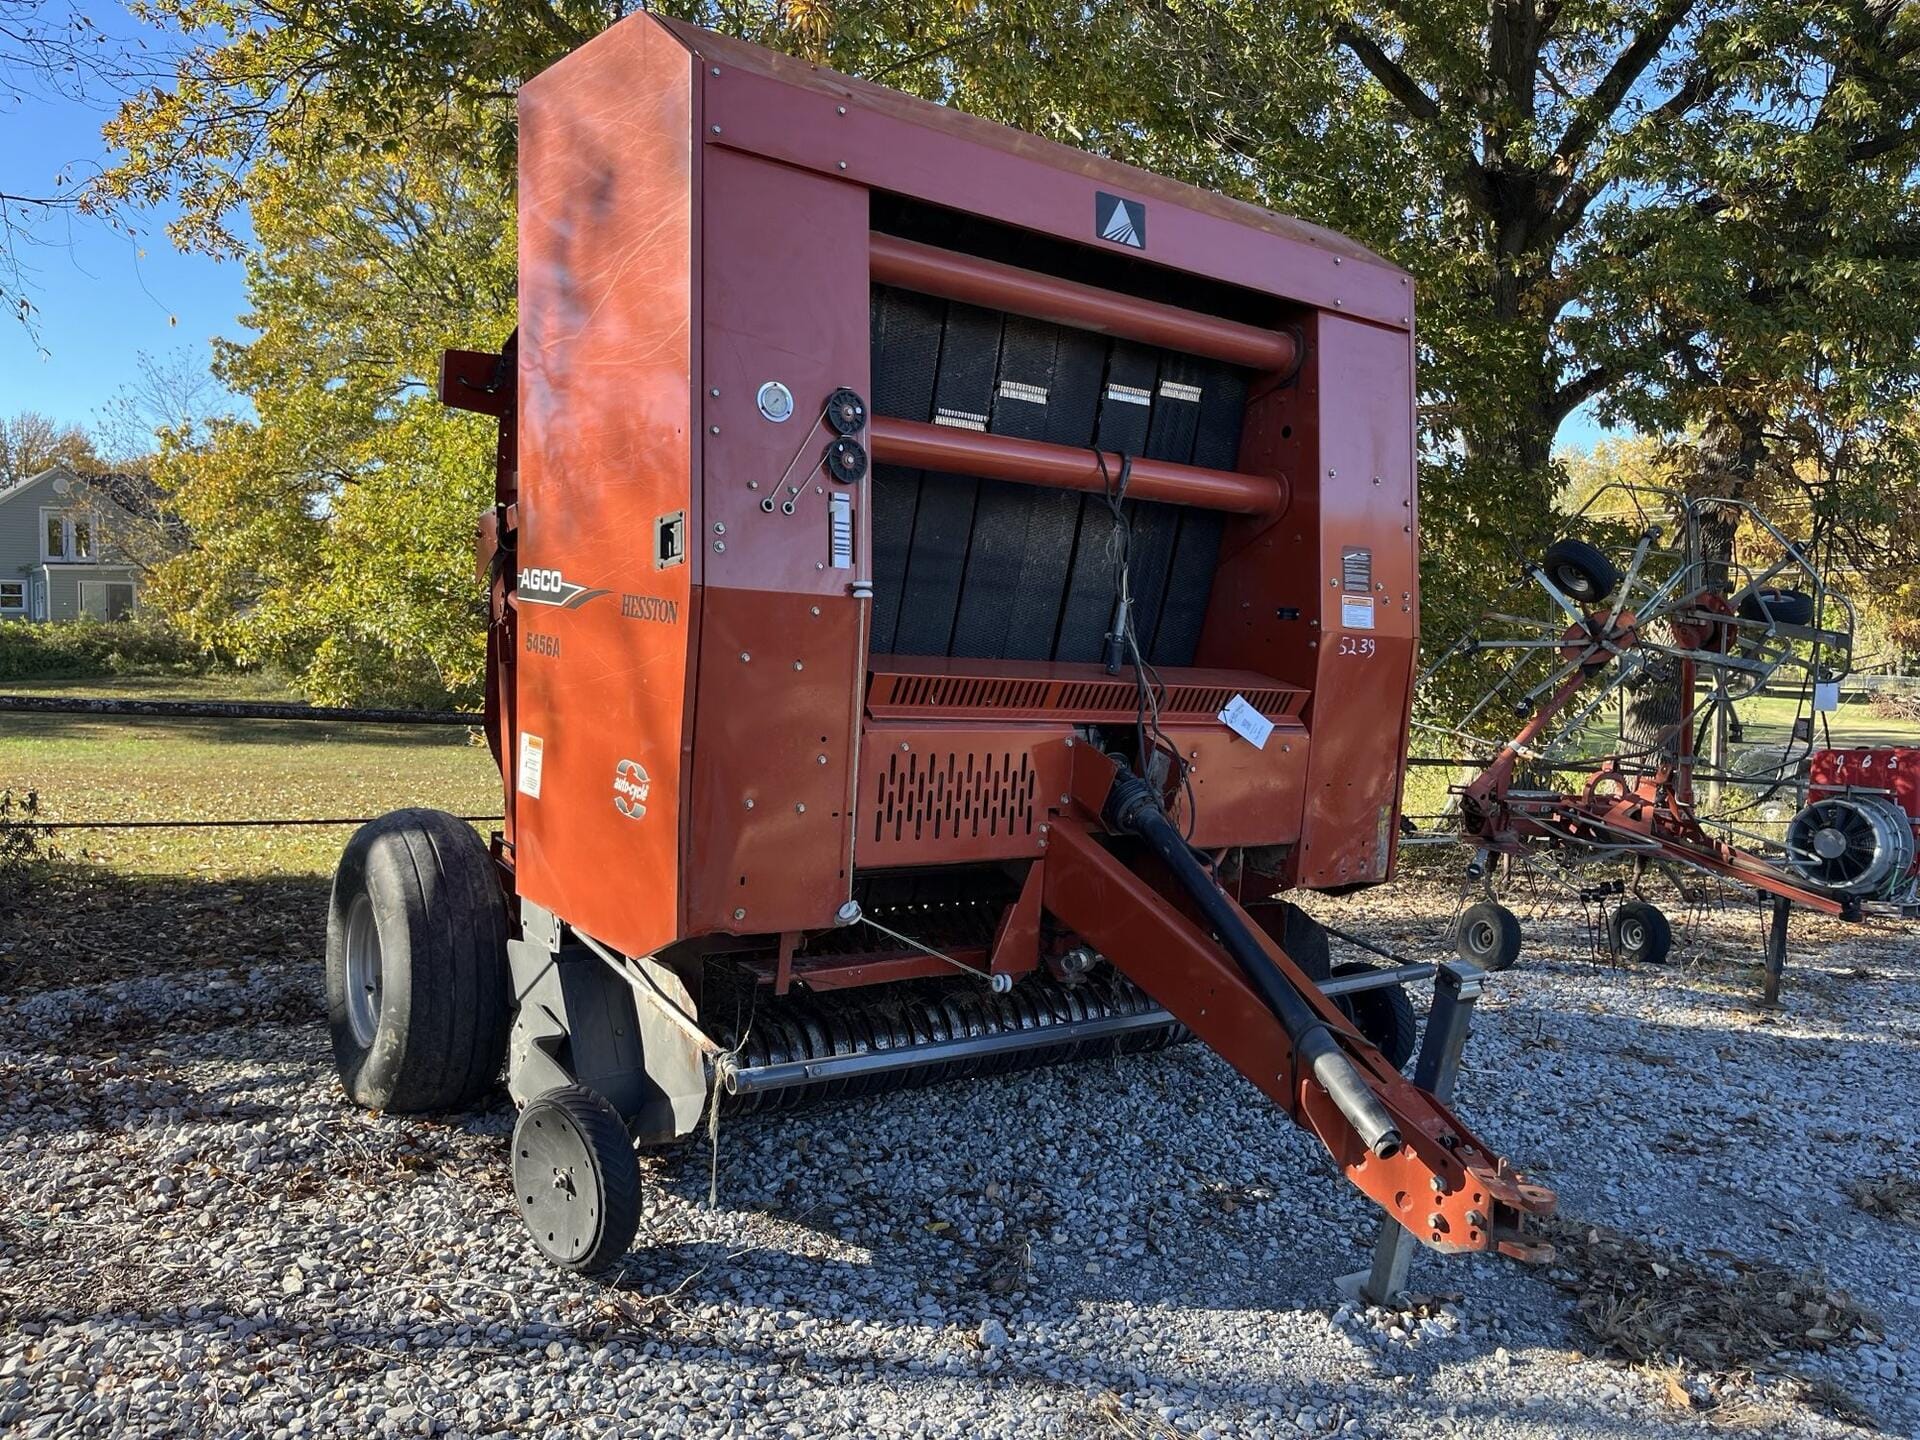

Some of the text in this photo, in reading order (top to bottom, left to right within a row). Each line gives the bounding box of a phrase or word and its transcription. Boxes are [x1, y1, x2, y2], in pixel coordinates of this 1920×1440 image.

[520, 567, 562, 593] AGCO
[621, 594, 679, 625] HESSTON
[526, 631, 560, 659] 5456A
[1338, 636, 1376, 659] 5239
